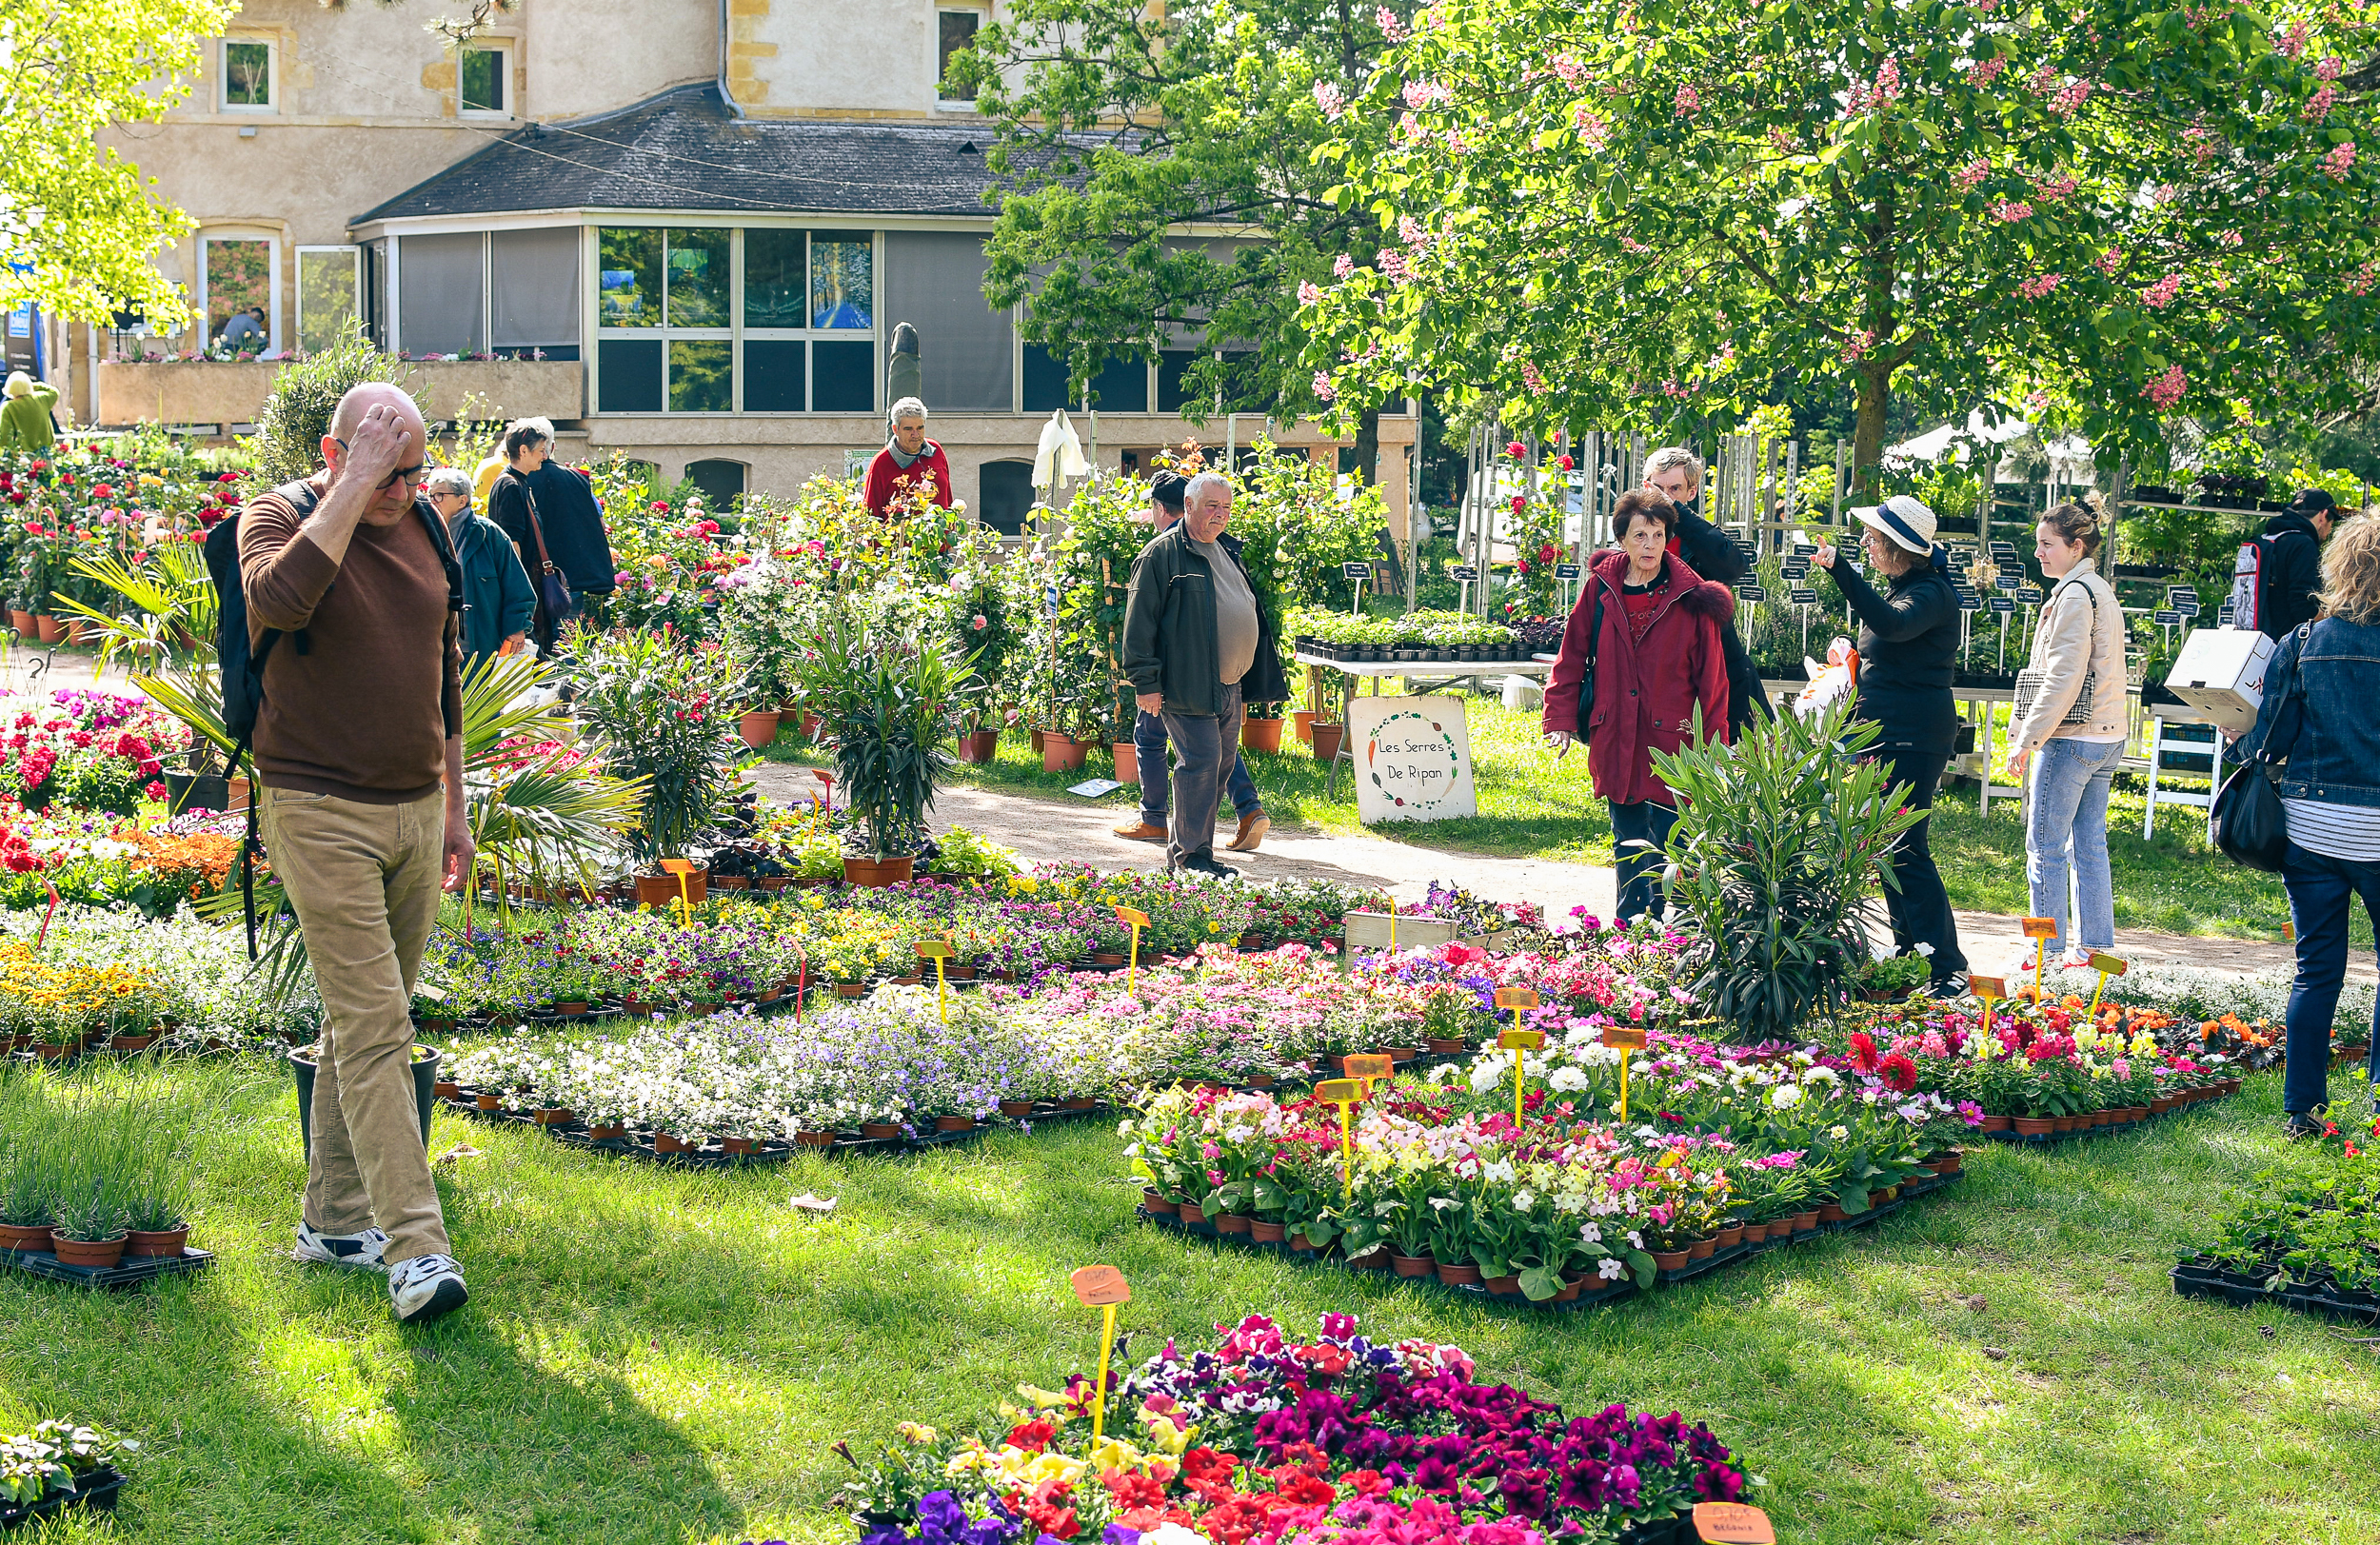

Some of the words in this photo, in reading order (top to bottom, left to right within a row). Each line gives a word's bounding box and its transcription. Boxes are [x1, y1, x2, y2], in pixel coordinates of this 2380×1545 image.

[1378, 739, 1400, 753] Les
[1404, 739, 1444, 753] Serres
[1387, 765, 1403, 780] De
[1408, 765, 1442, 786] Ripan
